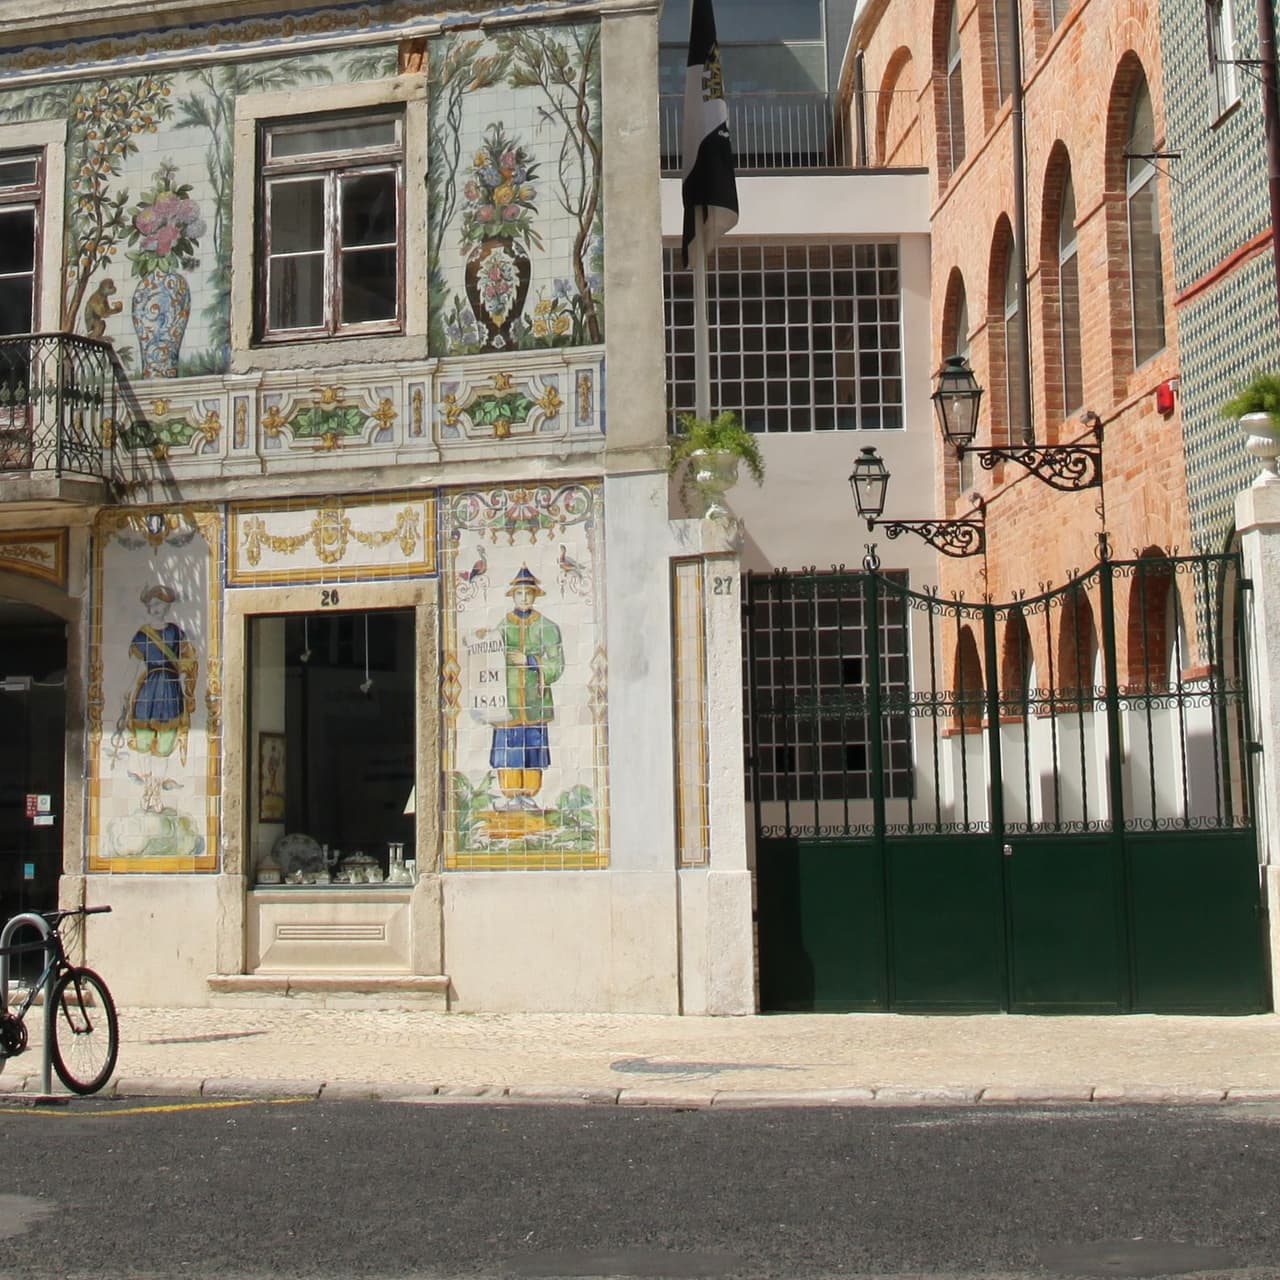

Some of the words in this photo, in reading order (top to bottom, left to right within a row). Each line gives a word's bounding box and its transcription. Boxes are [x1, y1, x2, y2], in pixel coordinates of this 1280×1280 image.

[714, 575, 733, 595] 27
[479, 670, 500, 683] EM
[474, 695, 506, 709] 1849
